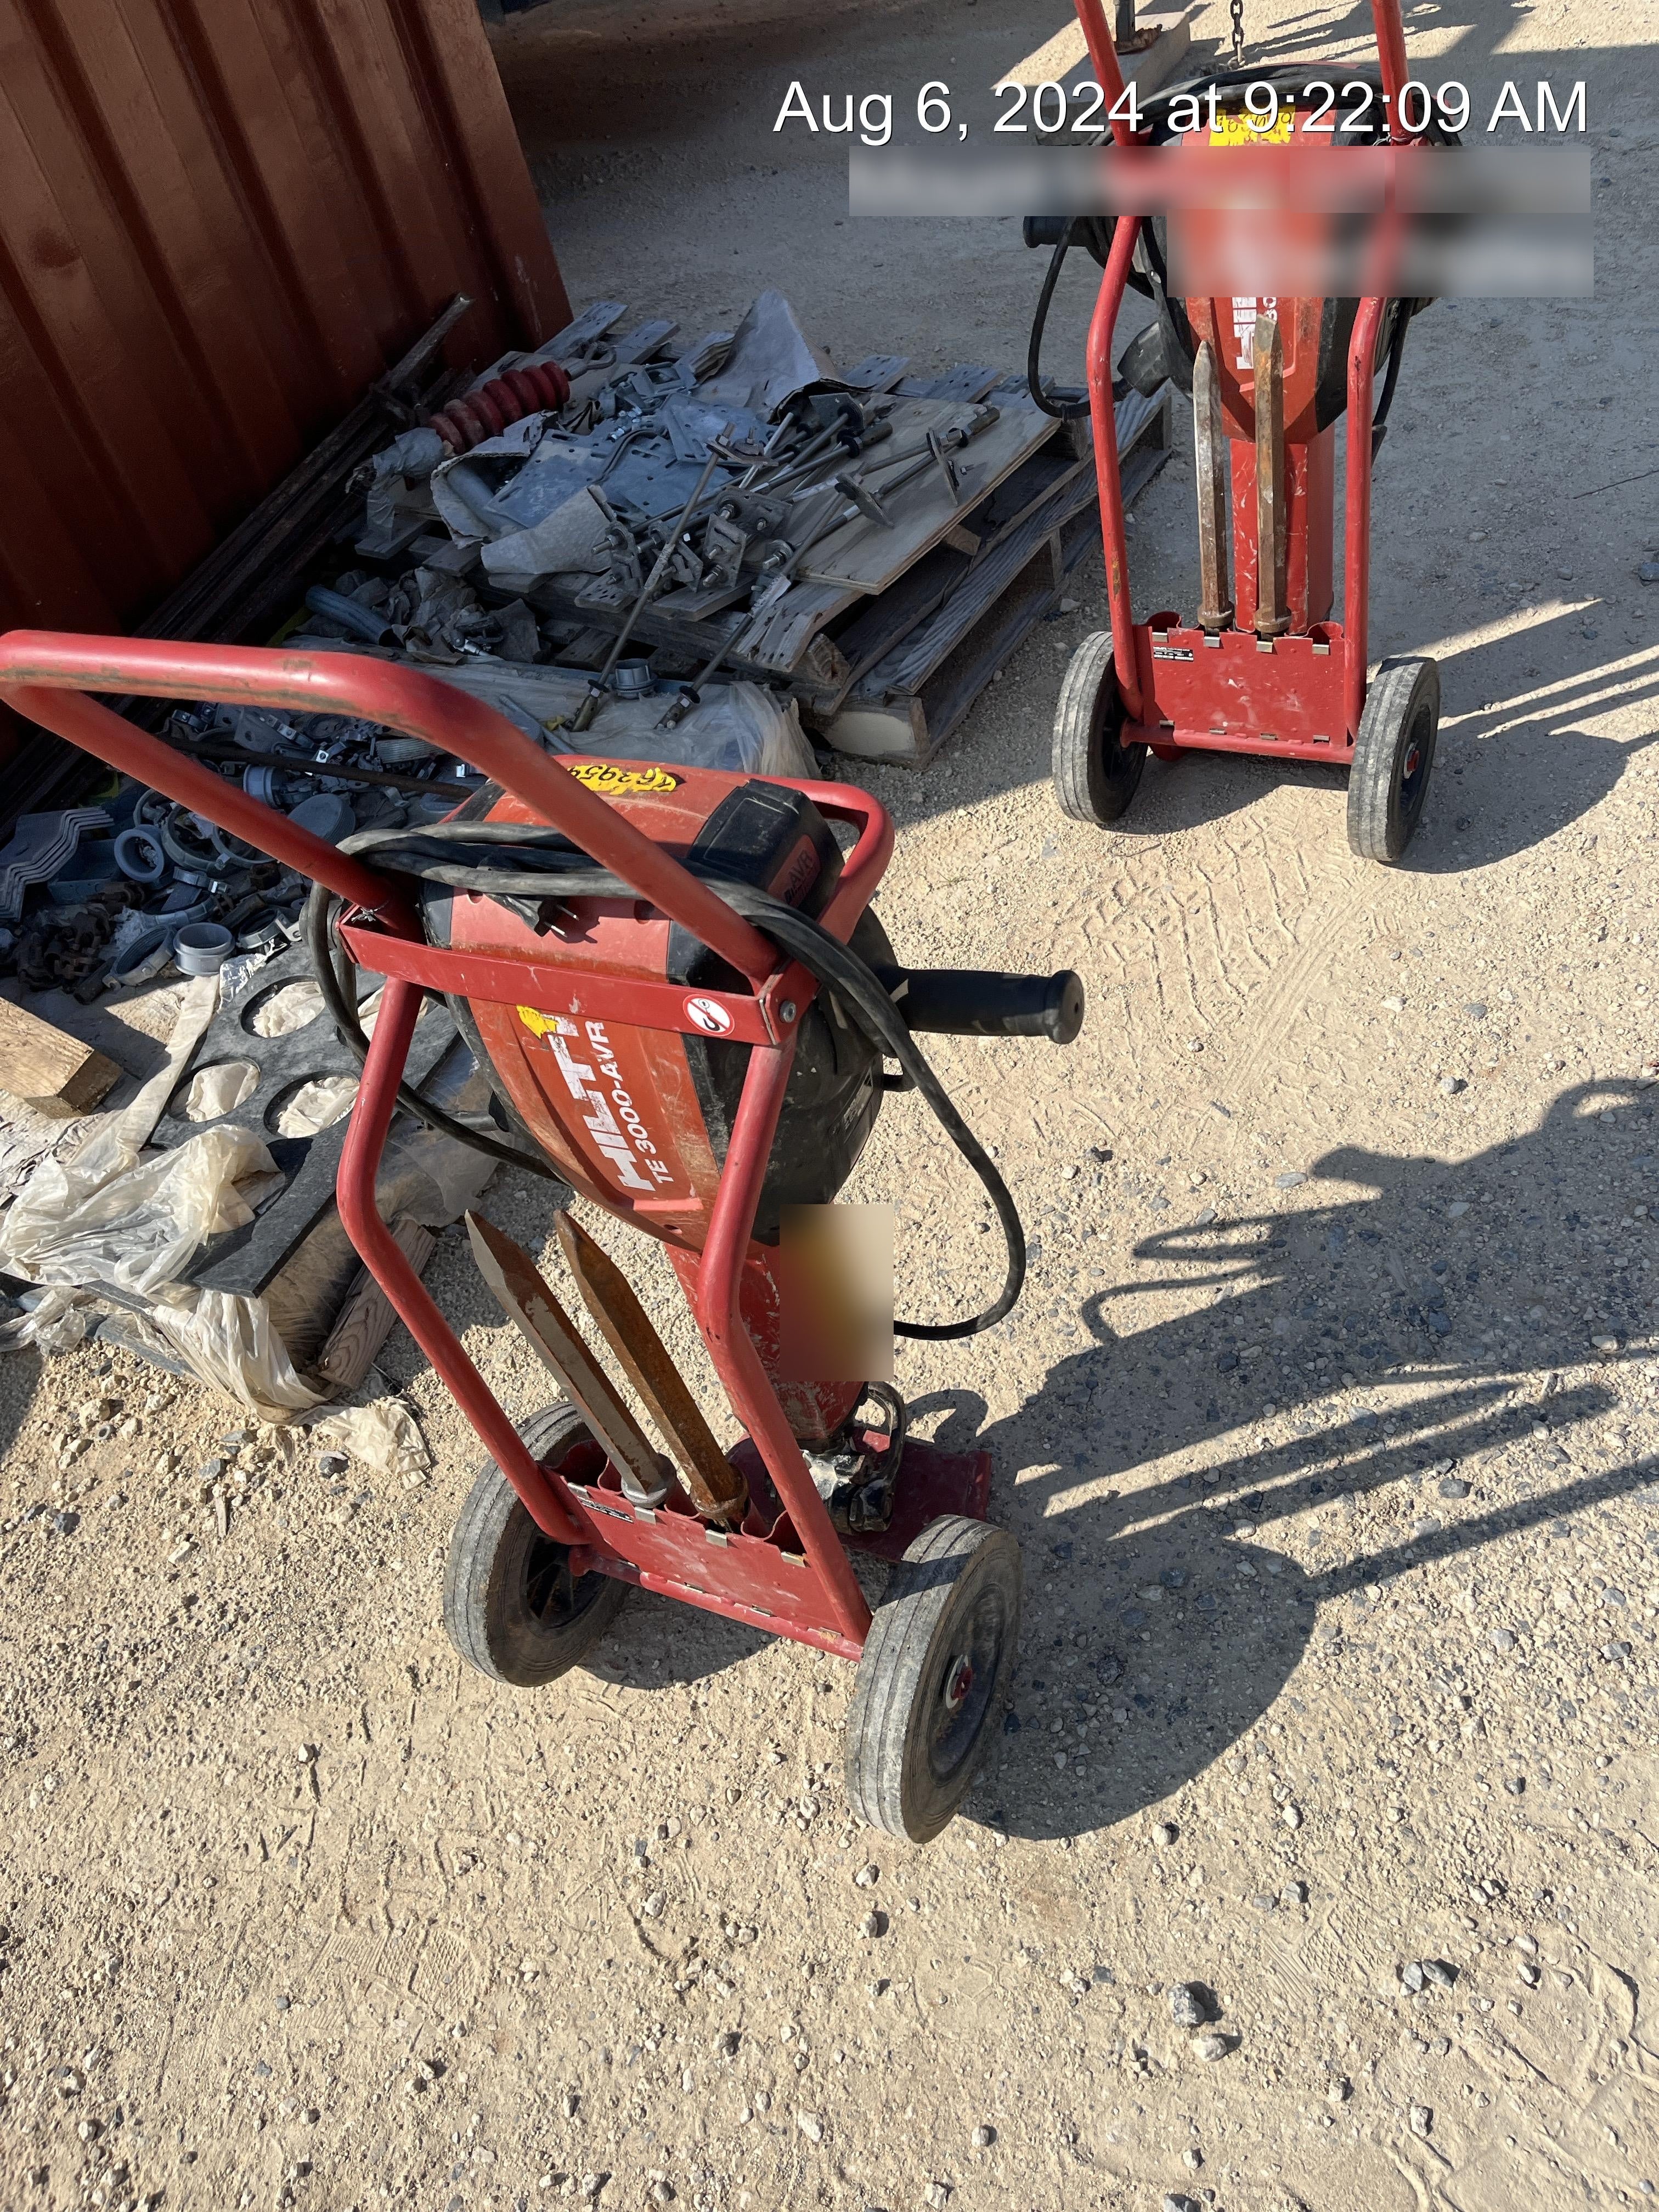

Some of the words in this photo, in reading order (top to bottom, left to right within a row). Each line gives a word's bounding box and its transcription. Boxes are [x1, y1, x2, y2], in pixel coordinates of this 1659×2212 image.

[540, 1014, 656, 1192] HILTI
[584, 1020, 657, 1154] 3000-AVR
[644, 1159, 674, 1183] TE
